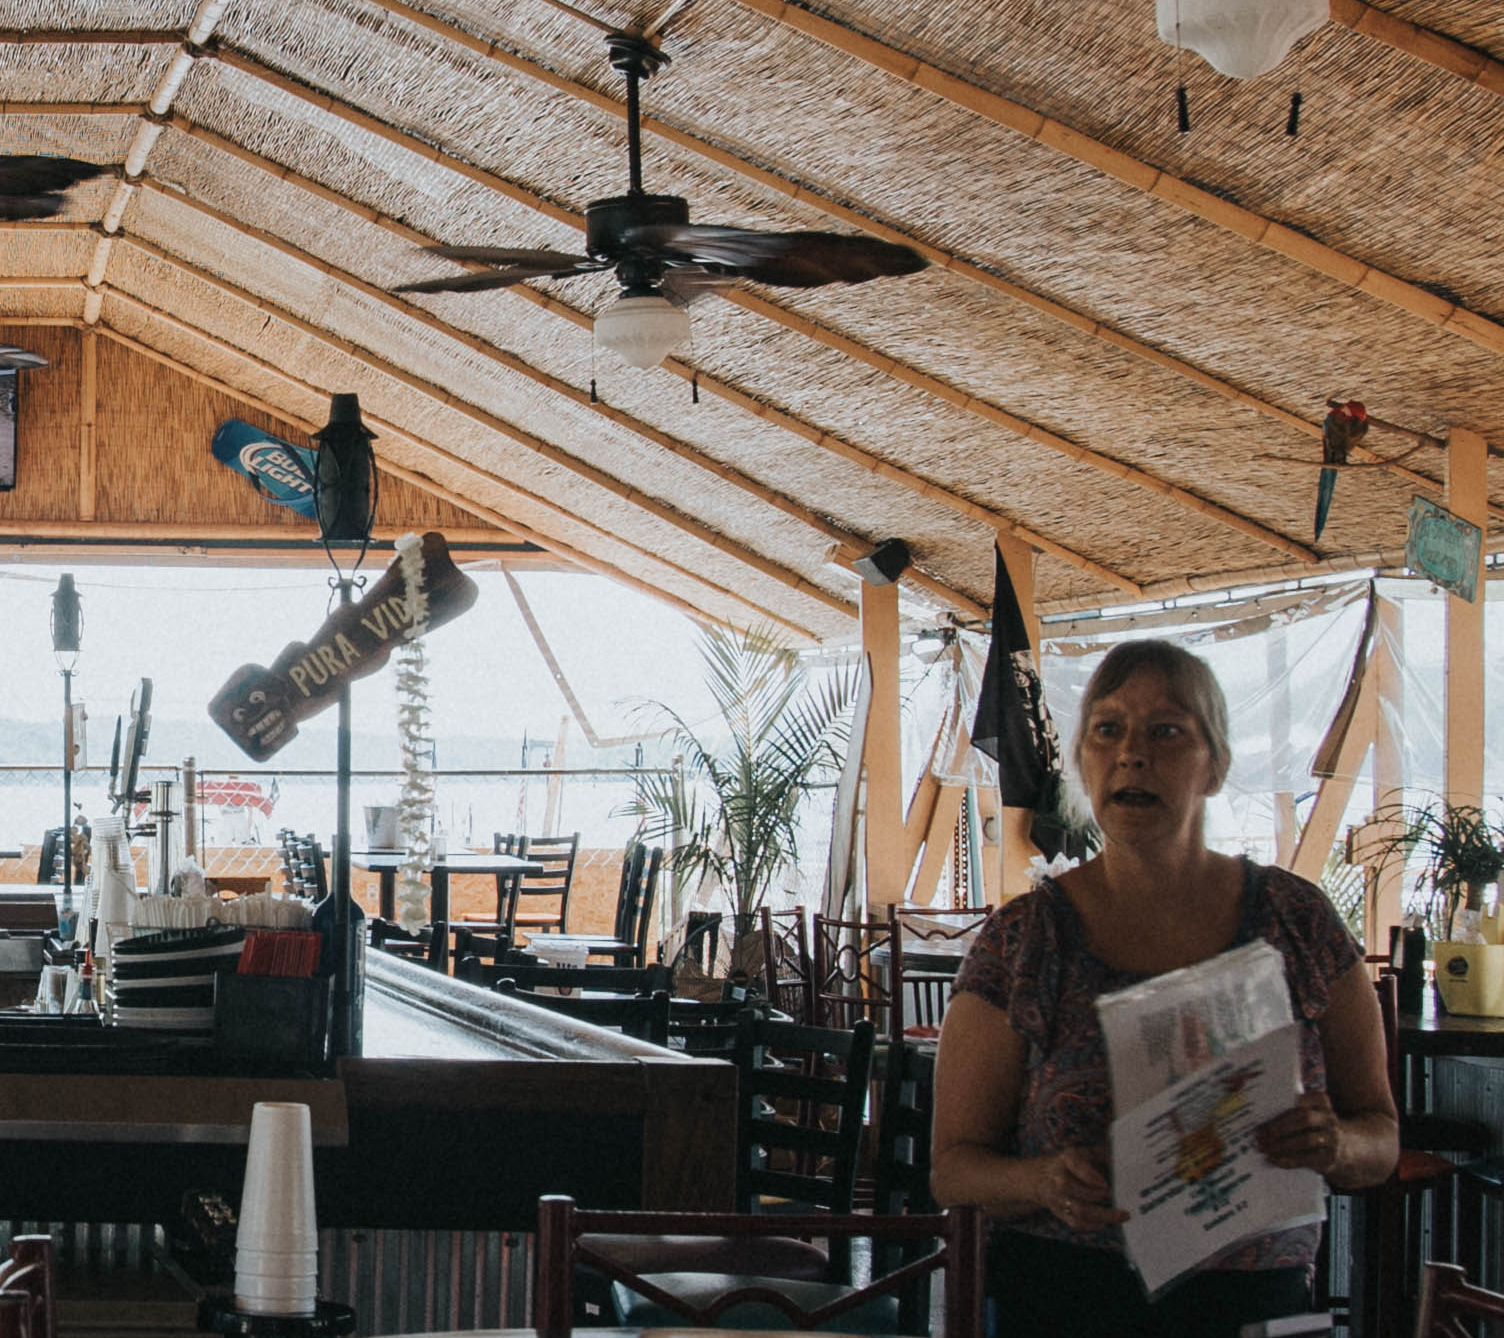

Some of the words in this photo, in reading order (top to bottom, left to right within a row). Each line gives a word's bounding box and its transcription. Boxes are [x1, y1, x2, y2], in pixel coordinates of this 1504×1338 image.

[250, 456, 315, 493] LIGHT
[289, 632, 361, 697] PURA
[361, 596, 413, 640] VID
